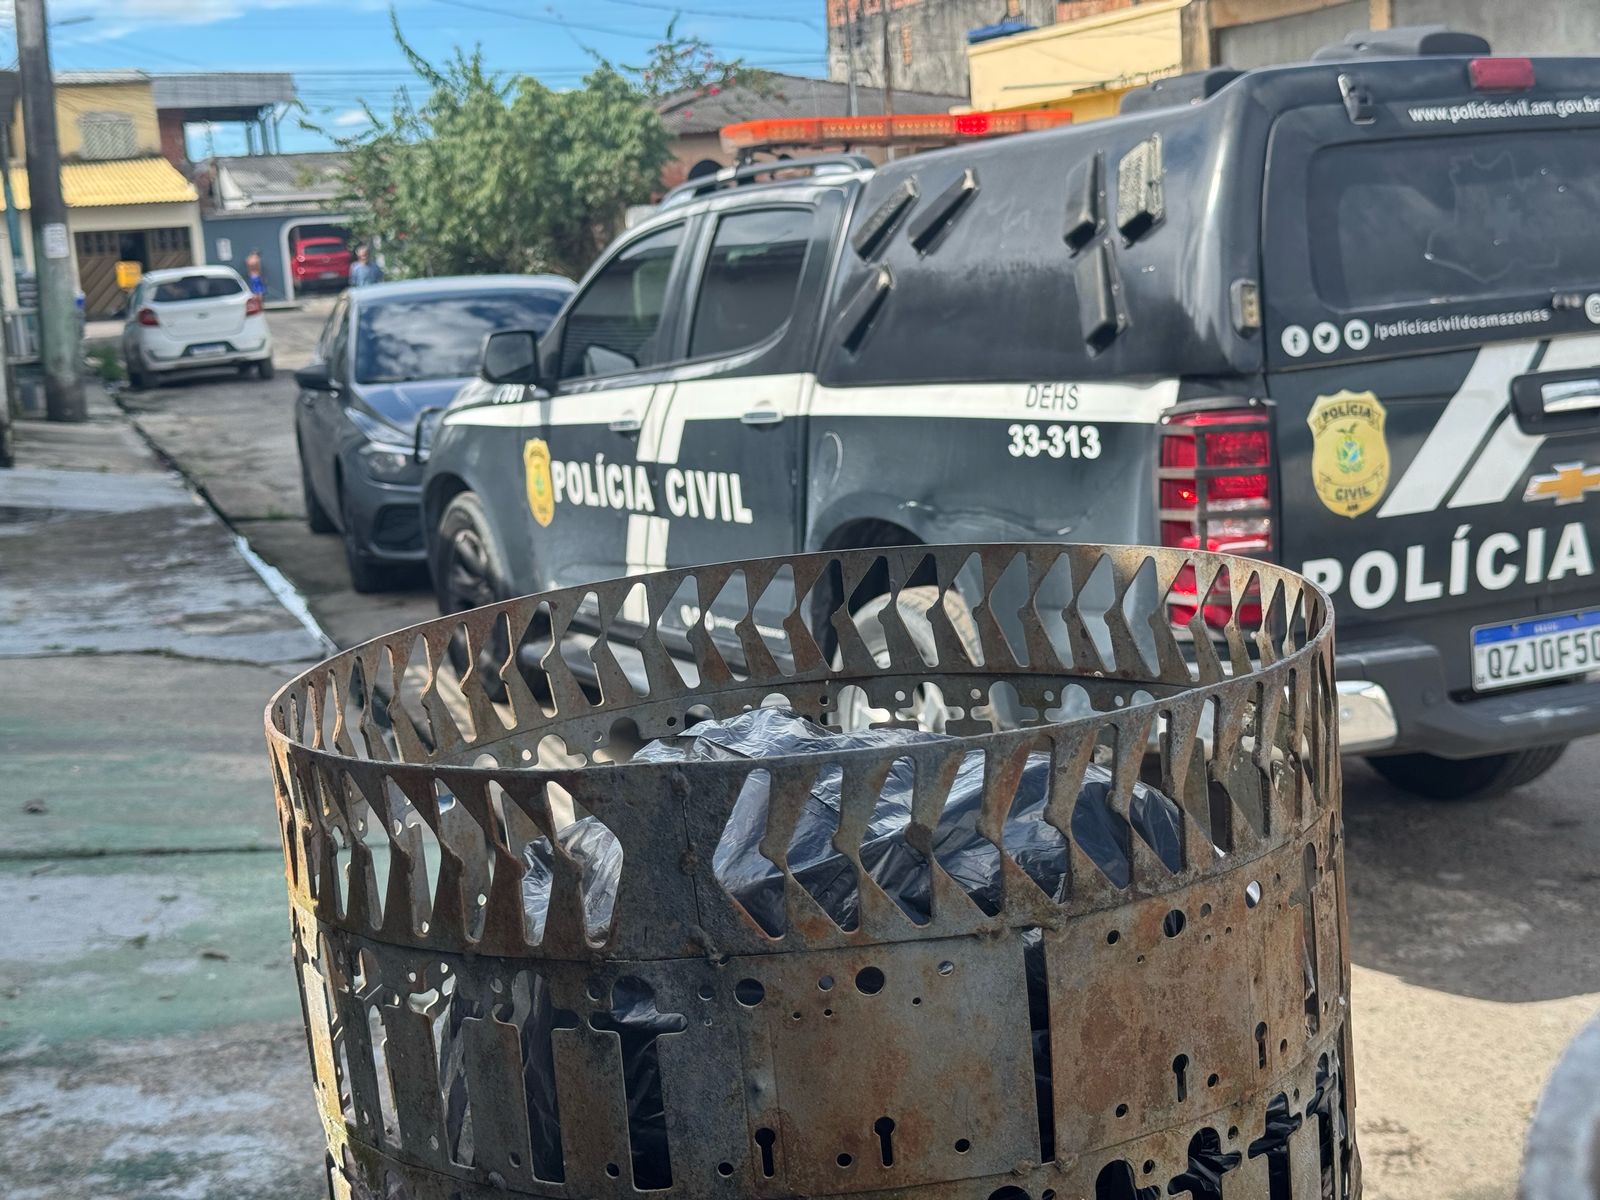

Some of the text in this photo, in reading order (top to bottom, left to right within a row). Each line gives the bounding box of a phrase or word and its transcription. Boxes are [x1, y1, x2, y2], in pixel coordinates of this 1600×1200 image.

[1026, 383, 1079, 410] DEHS
[1322, 402, 1372, 421] POLÍCIA
[1008, 423, 1102, 460] 33-313
[551, 452, 754, 524] POLÍCIA CIVIL
[1335, 486, 1373, 501] CIVIL
[1302, 522, 1594, 614] POLÍCIA
